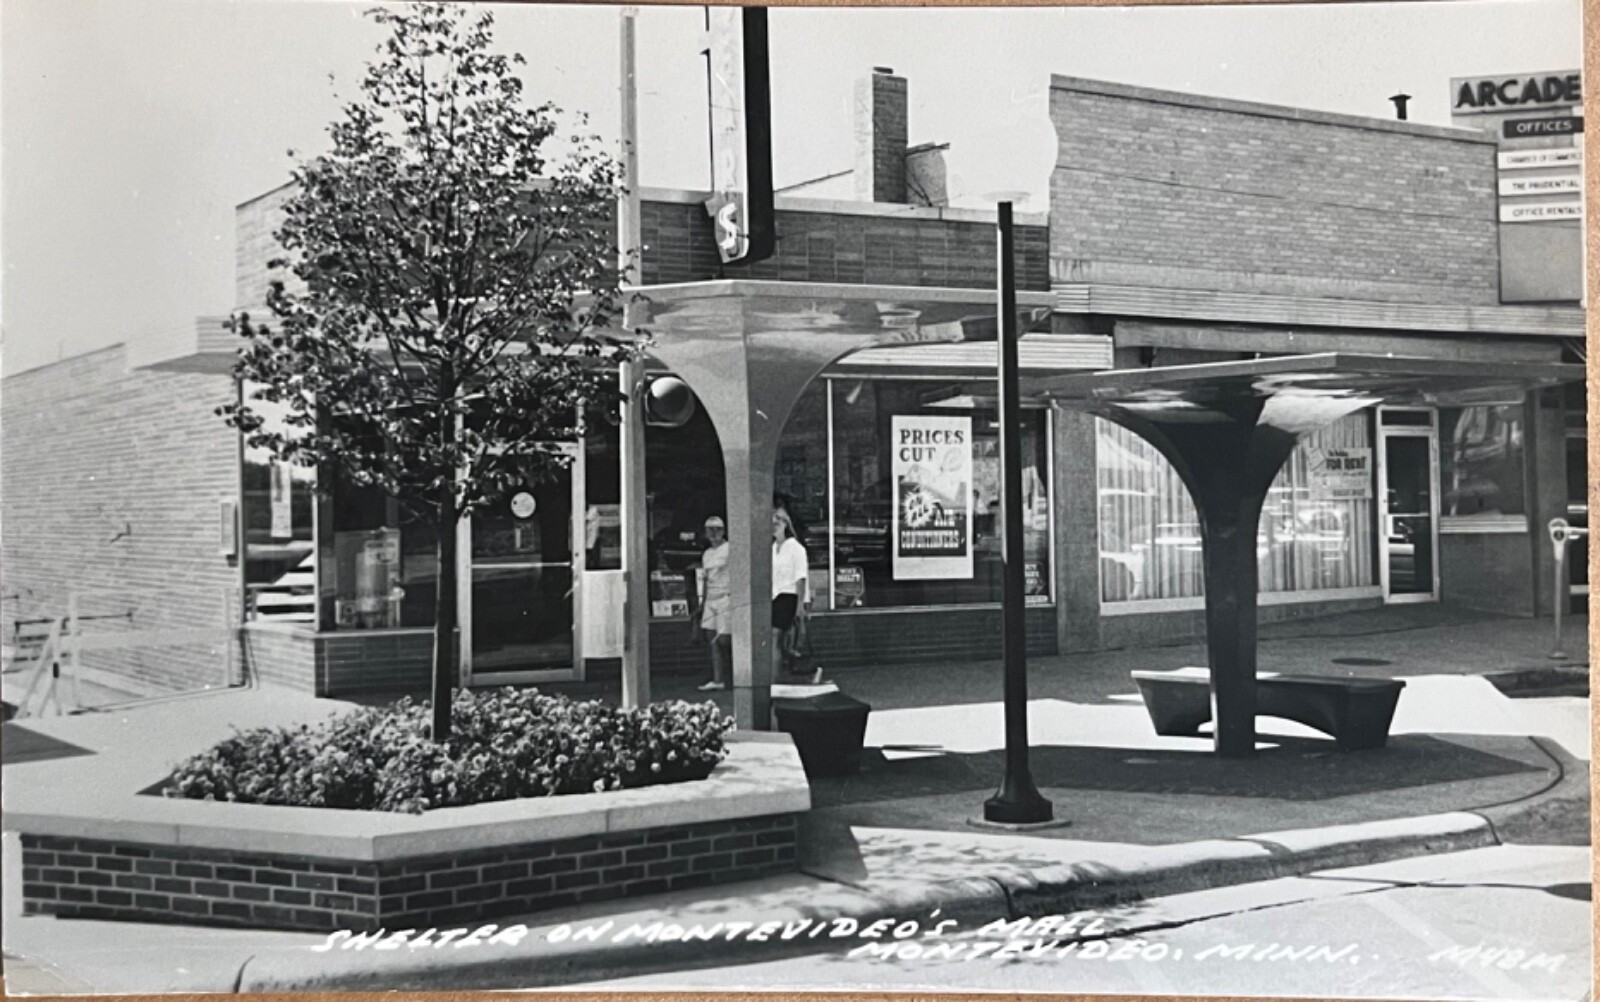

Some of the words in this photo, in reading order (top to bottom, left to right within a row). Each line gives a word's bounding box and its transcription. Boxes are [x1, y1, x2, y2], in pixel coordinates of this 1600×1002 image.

[1454, 73, 1581, 108] ARCADE
[1516, 120, 1573, 134] OFFICES
[1512, 182, 1526, 191] THE
[1529, 180, 1578, 190] PRUDENTIAL
[1512, 207, 1544, 218] OFFICE
[1546, 205, 1582, 216] RENTALS
[900, 429, 965, 446] PRICES
[900, 447, 937, 462] CUT
[1326, 458, 1342, 470] FOR
[1343, 456, 1366, 470] RENT
